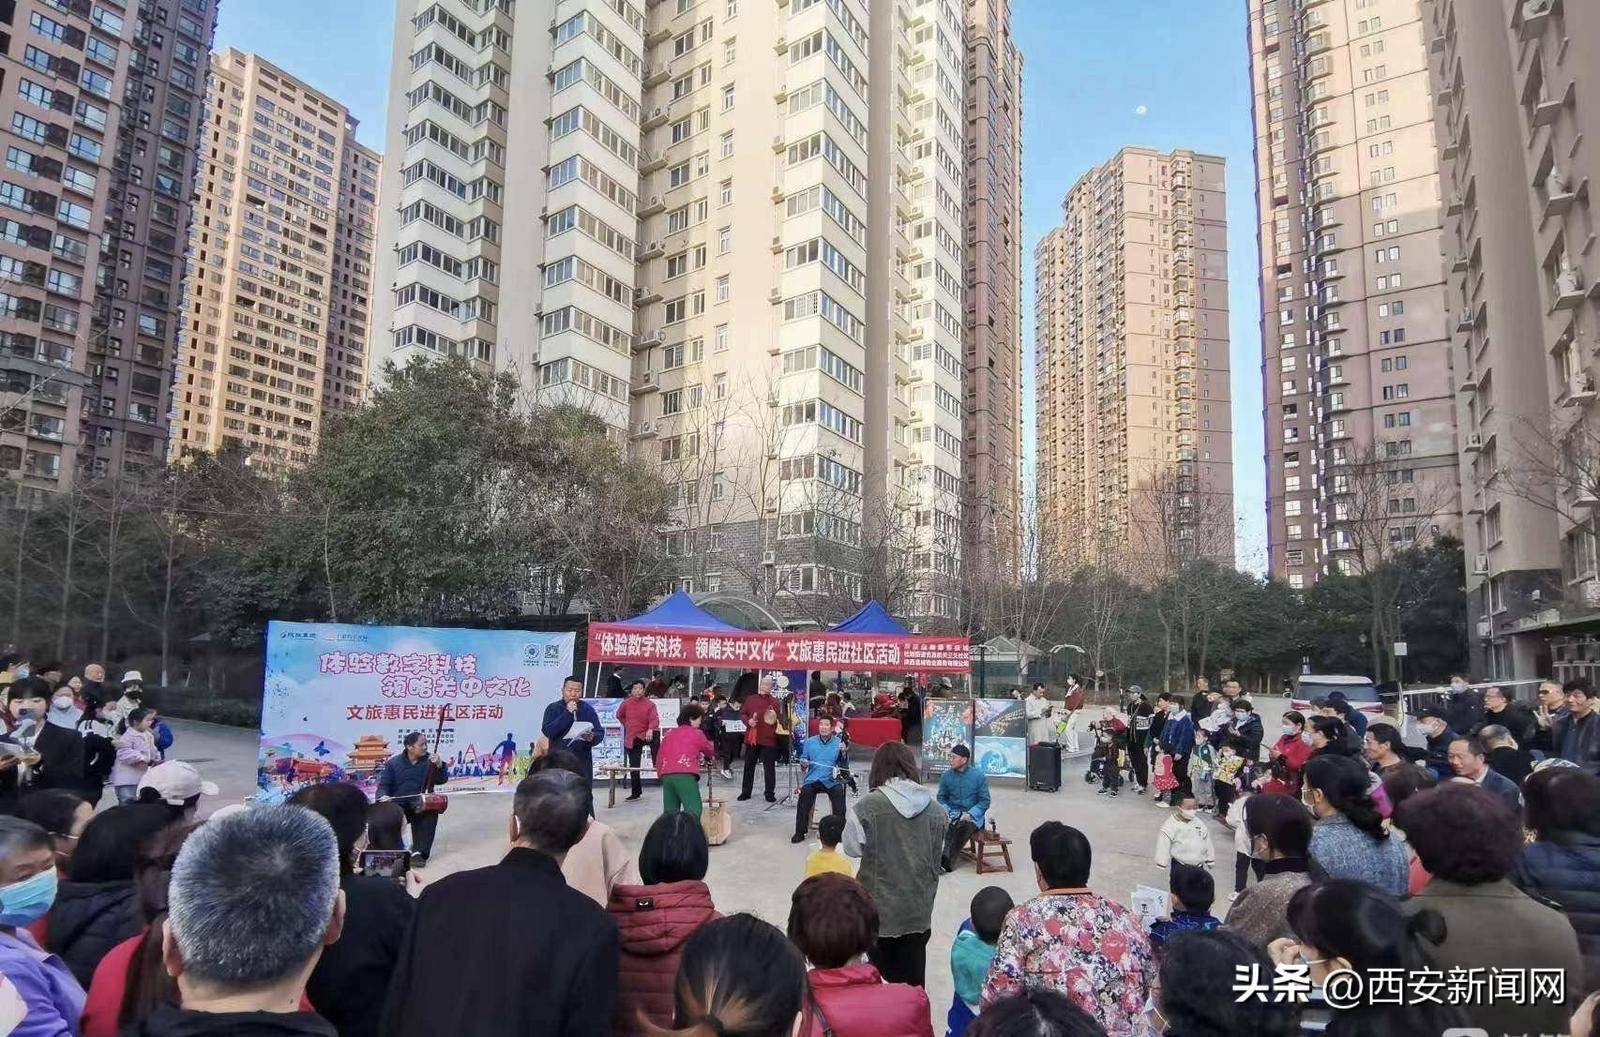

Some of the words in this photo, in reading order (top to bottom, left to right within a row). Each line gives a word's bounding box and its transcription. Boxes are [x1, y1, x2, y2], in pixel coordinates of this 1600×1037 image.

[319, 651, 478, 675] 体验数字科技
[786, 639, 900, 666] 文旅惠民进社区活动
[381, 675, 531, 698] 领略关中文化
[346, 704, 504, 721] 文旅惠民进社区活动
